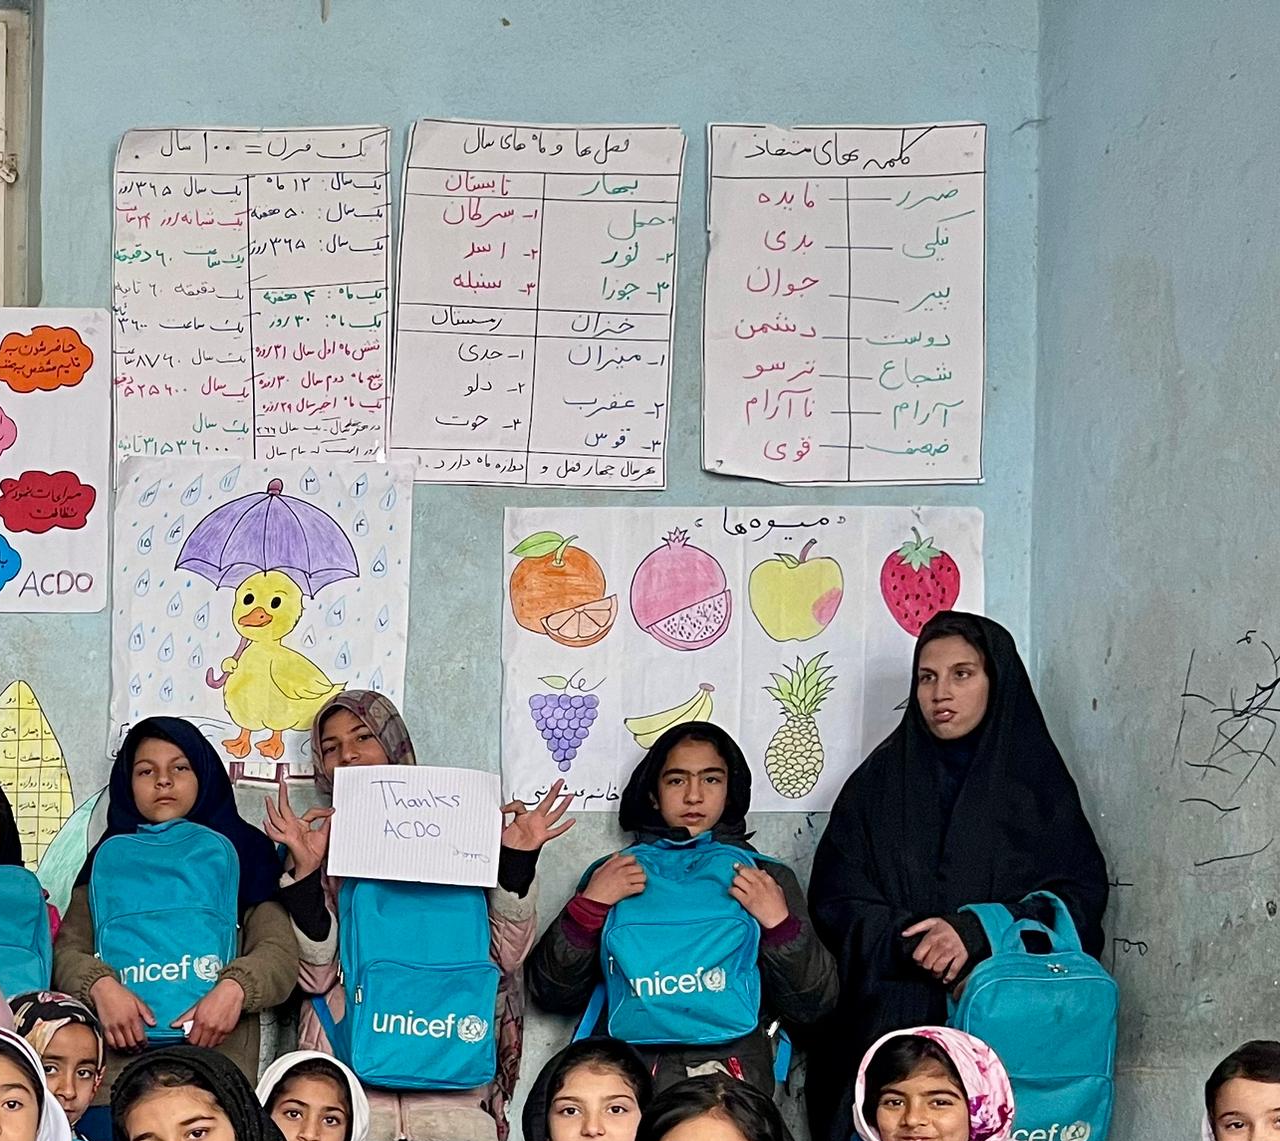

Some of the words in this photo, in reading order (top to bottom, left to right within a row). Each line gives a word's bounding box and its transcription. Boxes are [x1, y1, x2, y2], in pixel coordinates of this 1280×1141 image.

[161, 130, 191, 156] سال
[463, 127, 495, 155] سال
[184, 176, 207, 197] سال
[294, 176, 310, 192] ۱۲
[580, 174, 639, 196] بهار
[895, 180, 960, 210] ضرر
[442, 198, 515, 228] سرطان
[764, 230, 813, 256] بدی
[453, 271, 502, 295] سنبله
[746, 266, 820, 298] جوان
[735, 312, 817, 340] دشمن
[866, 331, 952, 348] دوست
[568, 344, 642, 372] میزان
[742, 360, 816, 383] ترسو
[464, 373, 493, 397] دلو
[879, 358, 953, 391] شجاع
[563, 392, 635, 418] عقرب
[892, 400, 964, 431] آرام
[435, 414, 489, 431] حوت
[584, 428, 631, 449] قوس
[764, 435, 812, 463] قوی
[19, 570, 94, 598] ACDO
[371, 779, 461, 810] Thanks
[583, 781, 620, 810] خانم
[384, 819, 441, 840] ACDO
[372, 1010, 457, 1040] unicef
